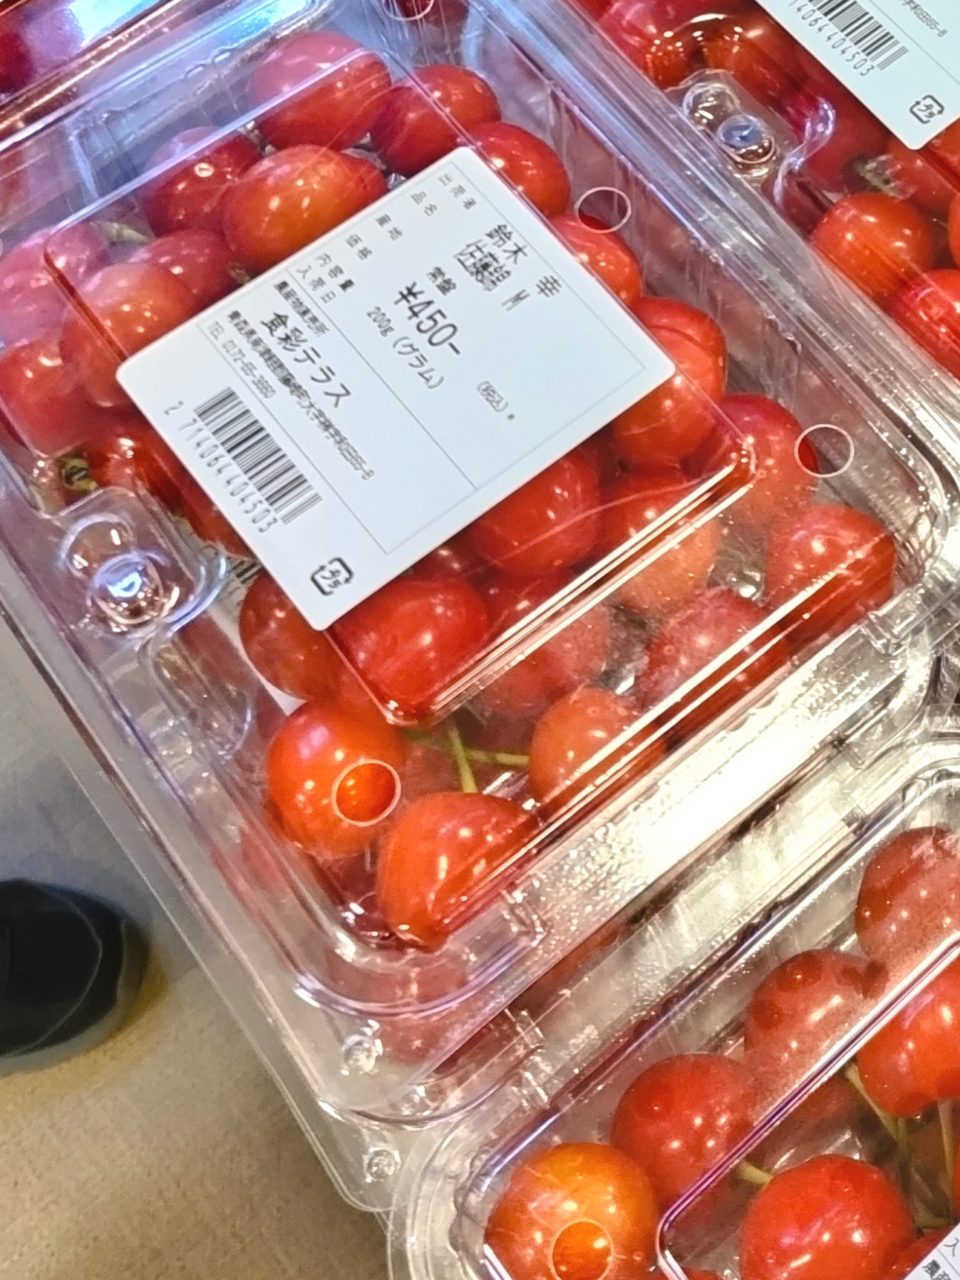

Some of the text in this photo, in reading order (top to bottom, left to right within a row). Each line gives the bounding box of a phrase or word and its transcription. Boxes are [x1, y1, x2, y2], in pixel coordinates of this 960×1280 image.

[315, 253, 354, 293] 内容量
[375, 214, 457, 296] 産地 常盤
[411, 192, 531, 311] 品名 佐藤錦 M
[440, 174, 563, 298] 出荷者 鈴木 幸
[295, 264, 336, 304] 入荷日
[343, 234, 372, 261] 価格
[392, 281, 460, 354] ¥450-
[207, 319, 226, 340] TEL
[259, 312, 350, 408] 食彩テラス
[164, 398, 185, 414] 2
